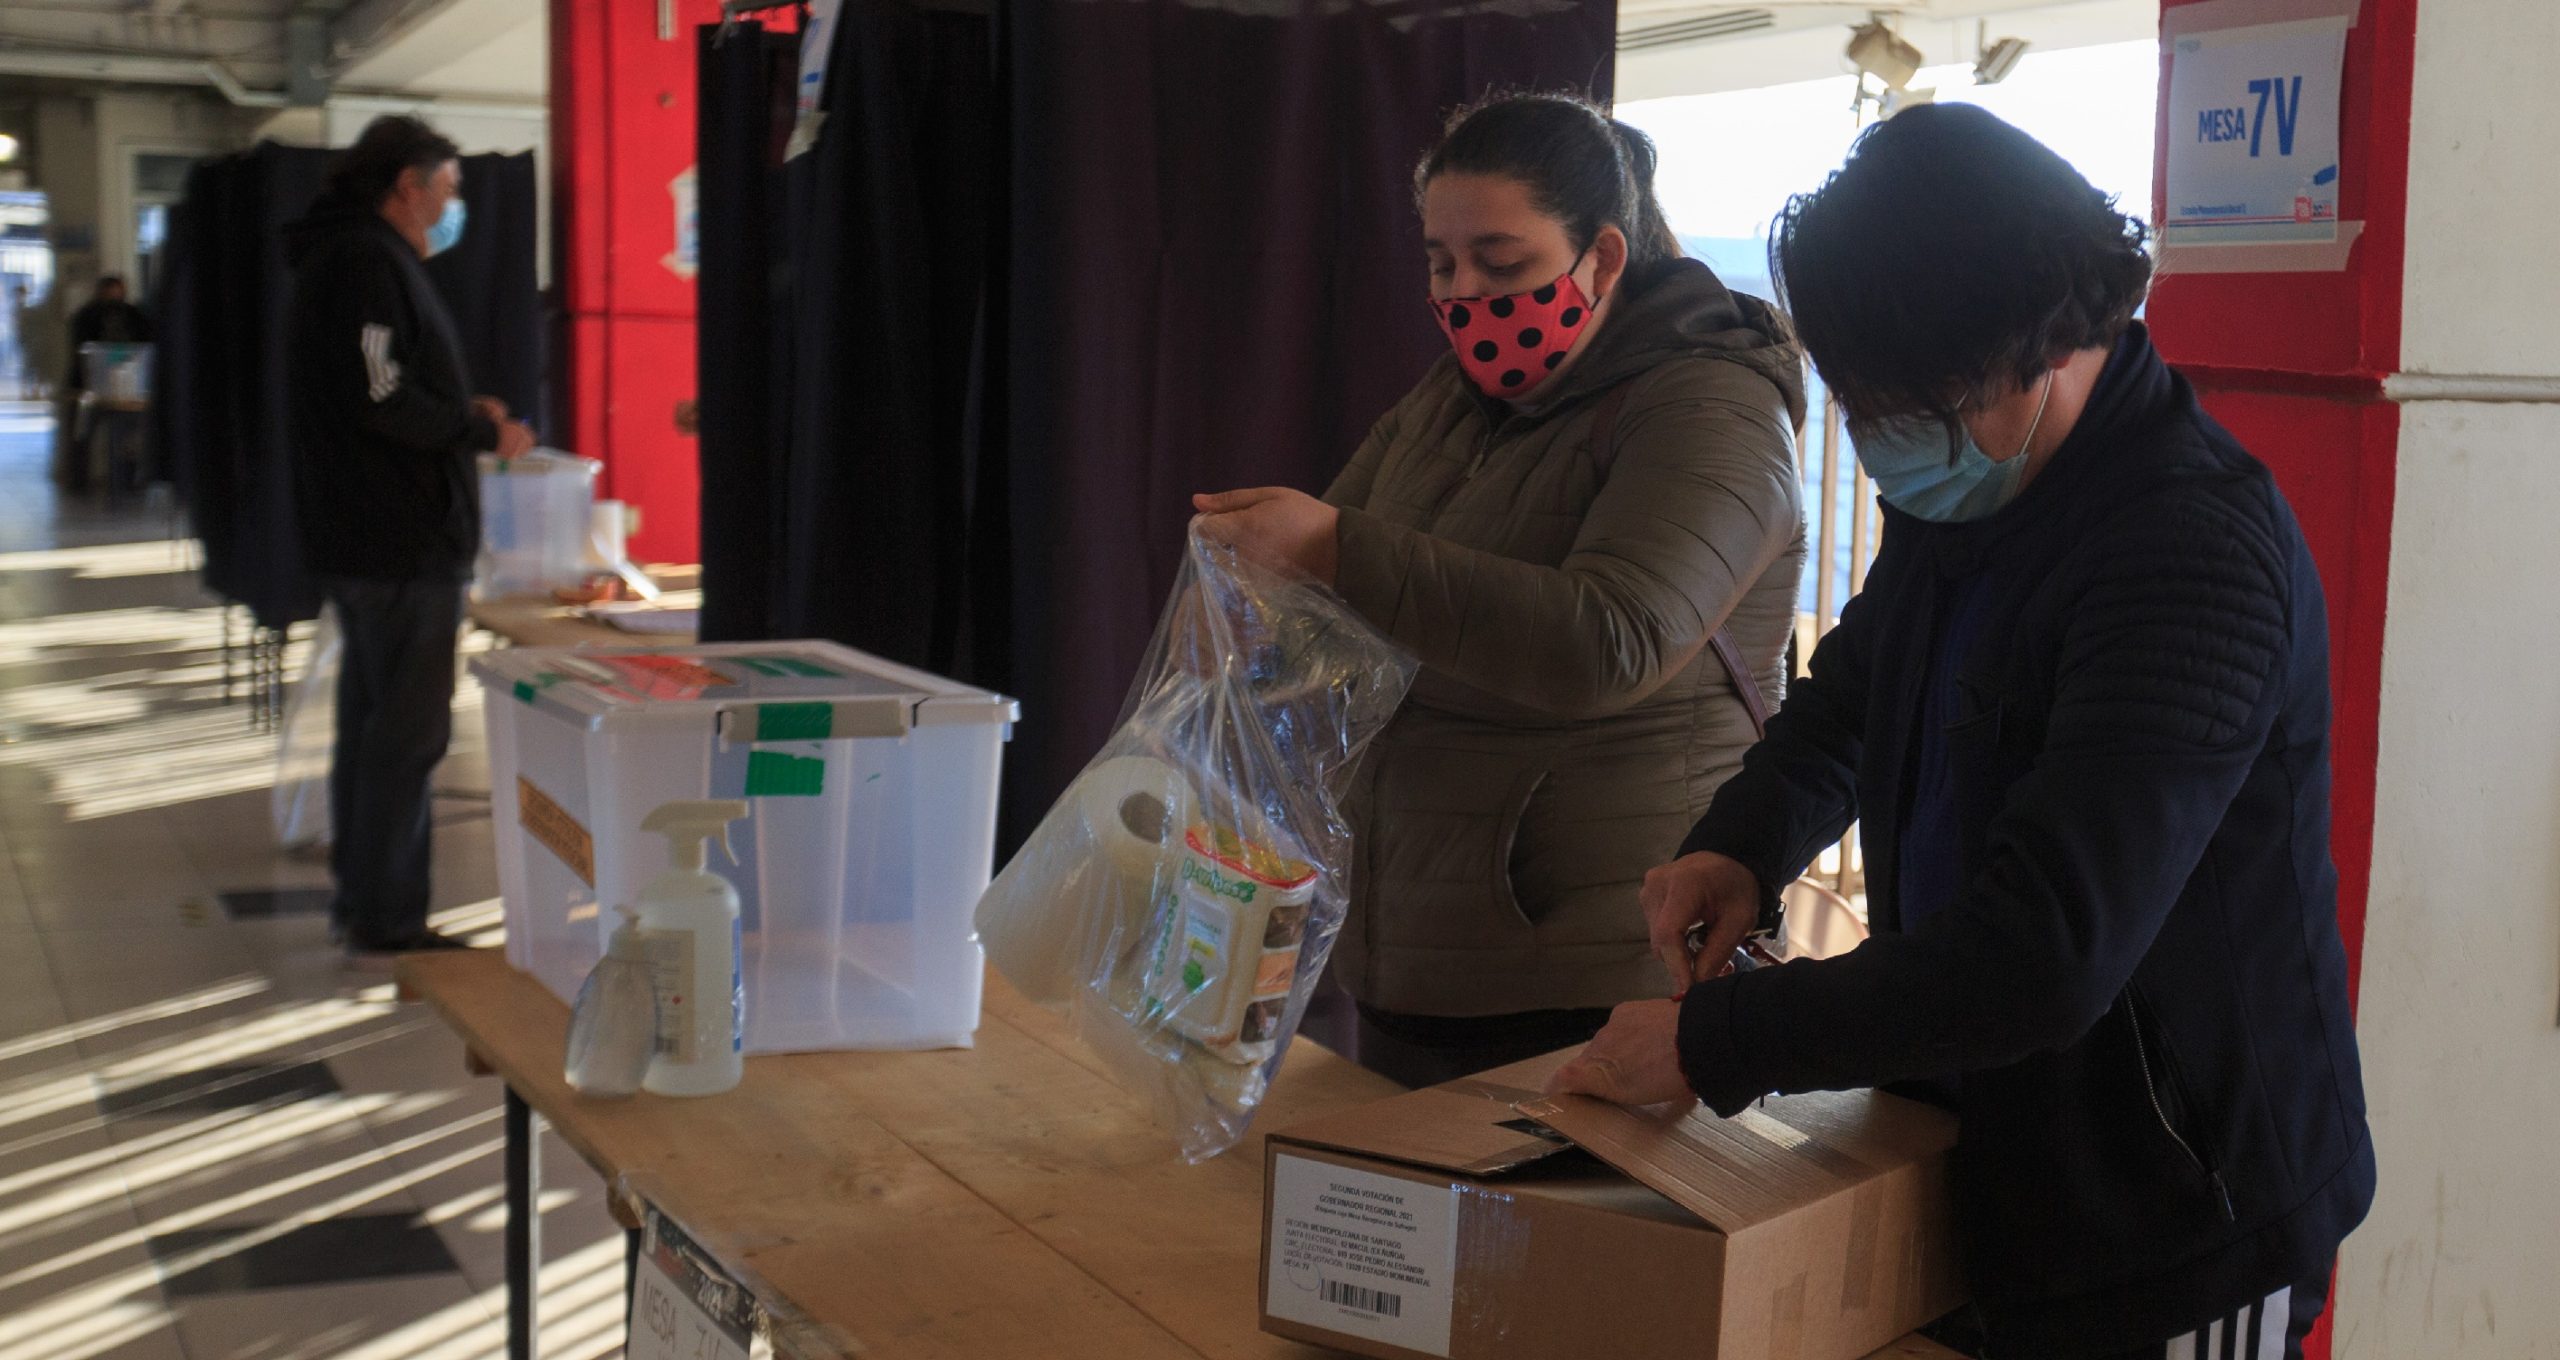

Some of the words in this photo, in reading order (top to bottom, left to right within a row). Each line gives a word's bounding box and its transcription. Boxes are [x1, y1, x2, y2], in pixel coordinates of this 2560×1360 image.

[2198, 107, 2246, 143] MESA
[2248, 76, 2302, 157] 7V
[1329, 1182, 1360, 1197] SEGUNDA
[1361, 1189, 1395, 1203] VOTACIÓN
[1395, 1196, 1404, 1204] DE
[1319, 1194, 1364, 1211] GOBERNADOR
[1364, 1203, 1398, 1218] REGIONAL
[1398, 1211, 1413, 1221] 2021
[1310, 1222, 1360, 1241] METROPOLITANA
[1361, 1232, 1369, 1242] DE
[1370, 1235, 1402, 1249] SANTIAGO
[1348, 1242, 1369, 1254] MACUL
[1362, 1265, 1388, 1278] ESTADIO
[1389, 1269, 1431, 1287] MONUMENTAL
[1364, 1254, 1386, 1267] PEDRO
[1386, 1259, 1425, 1275] ALESSANDRI
[641, 1278, 676, 1353] MESA
